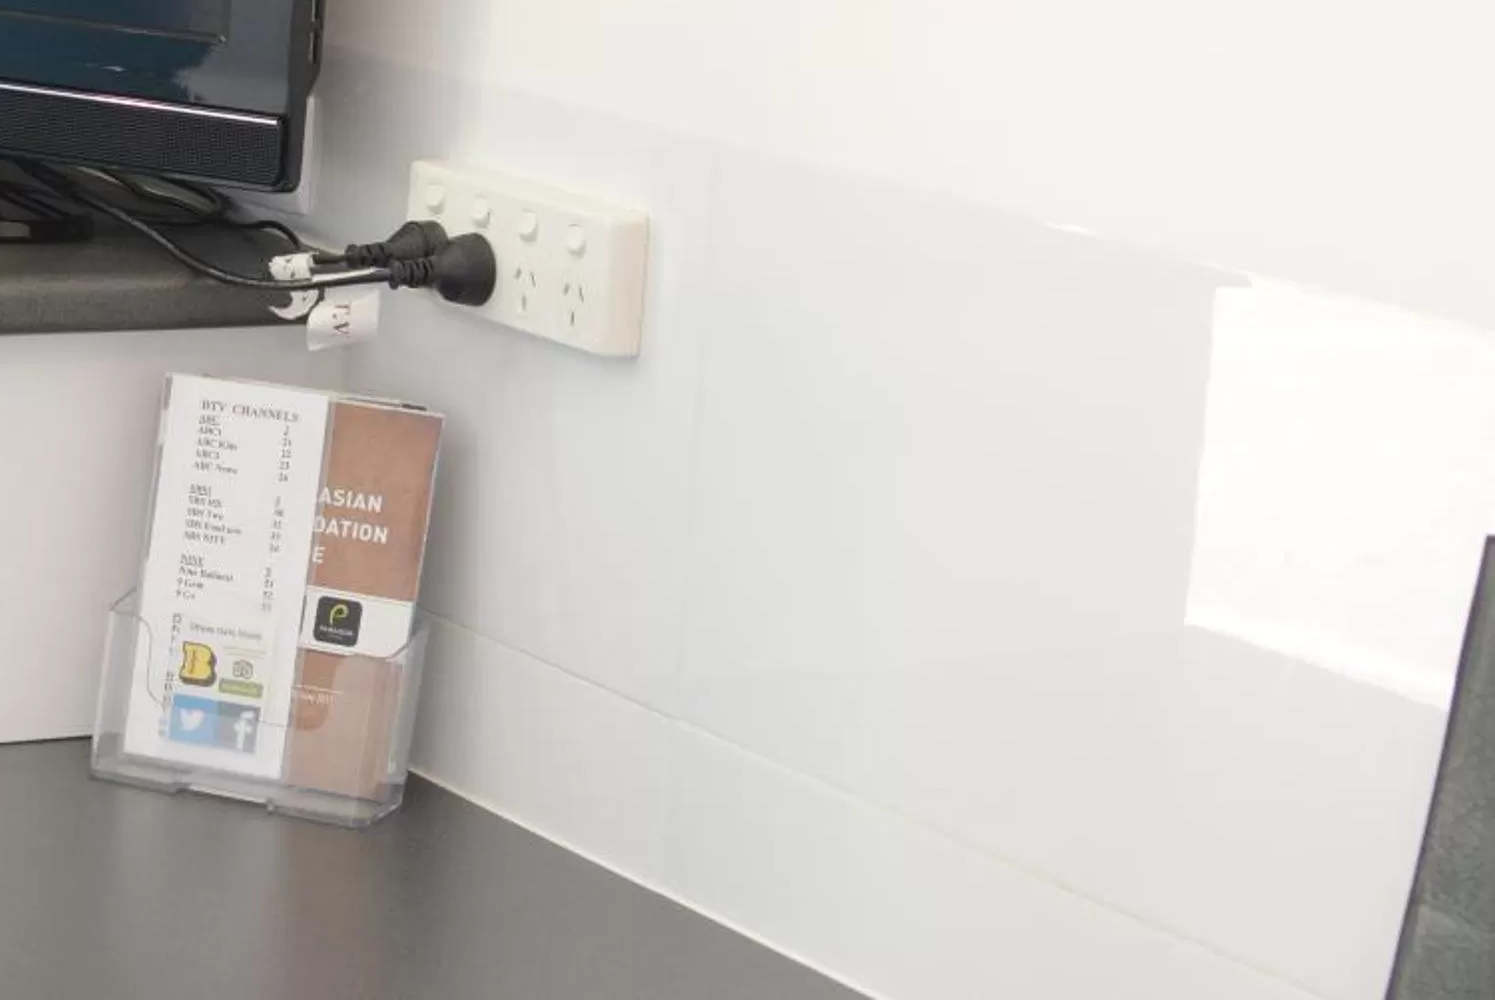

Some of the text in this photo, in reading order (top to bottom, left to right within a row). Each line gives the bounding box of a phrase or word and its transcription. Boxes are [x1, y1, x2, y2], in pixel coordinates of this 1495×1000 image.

[201, 399, 301, 423] DTV CHANNELS
[319, 486, 383, 513] ASIAN
